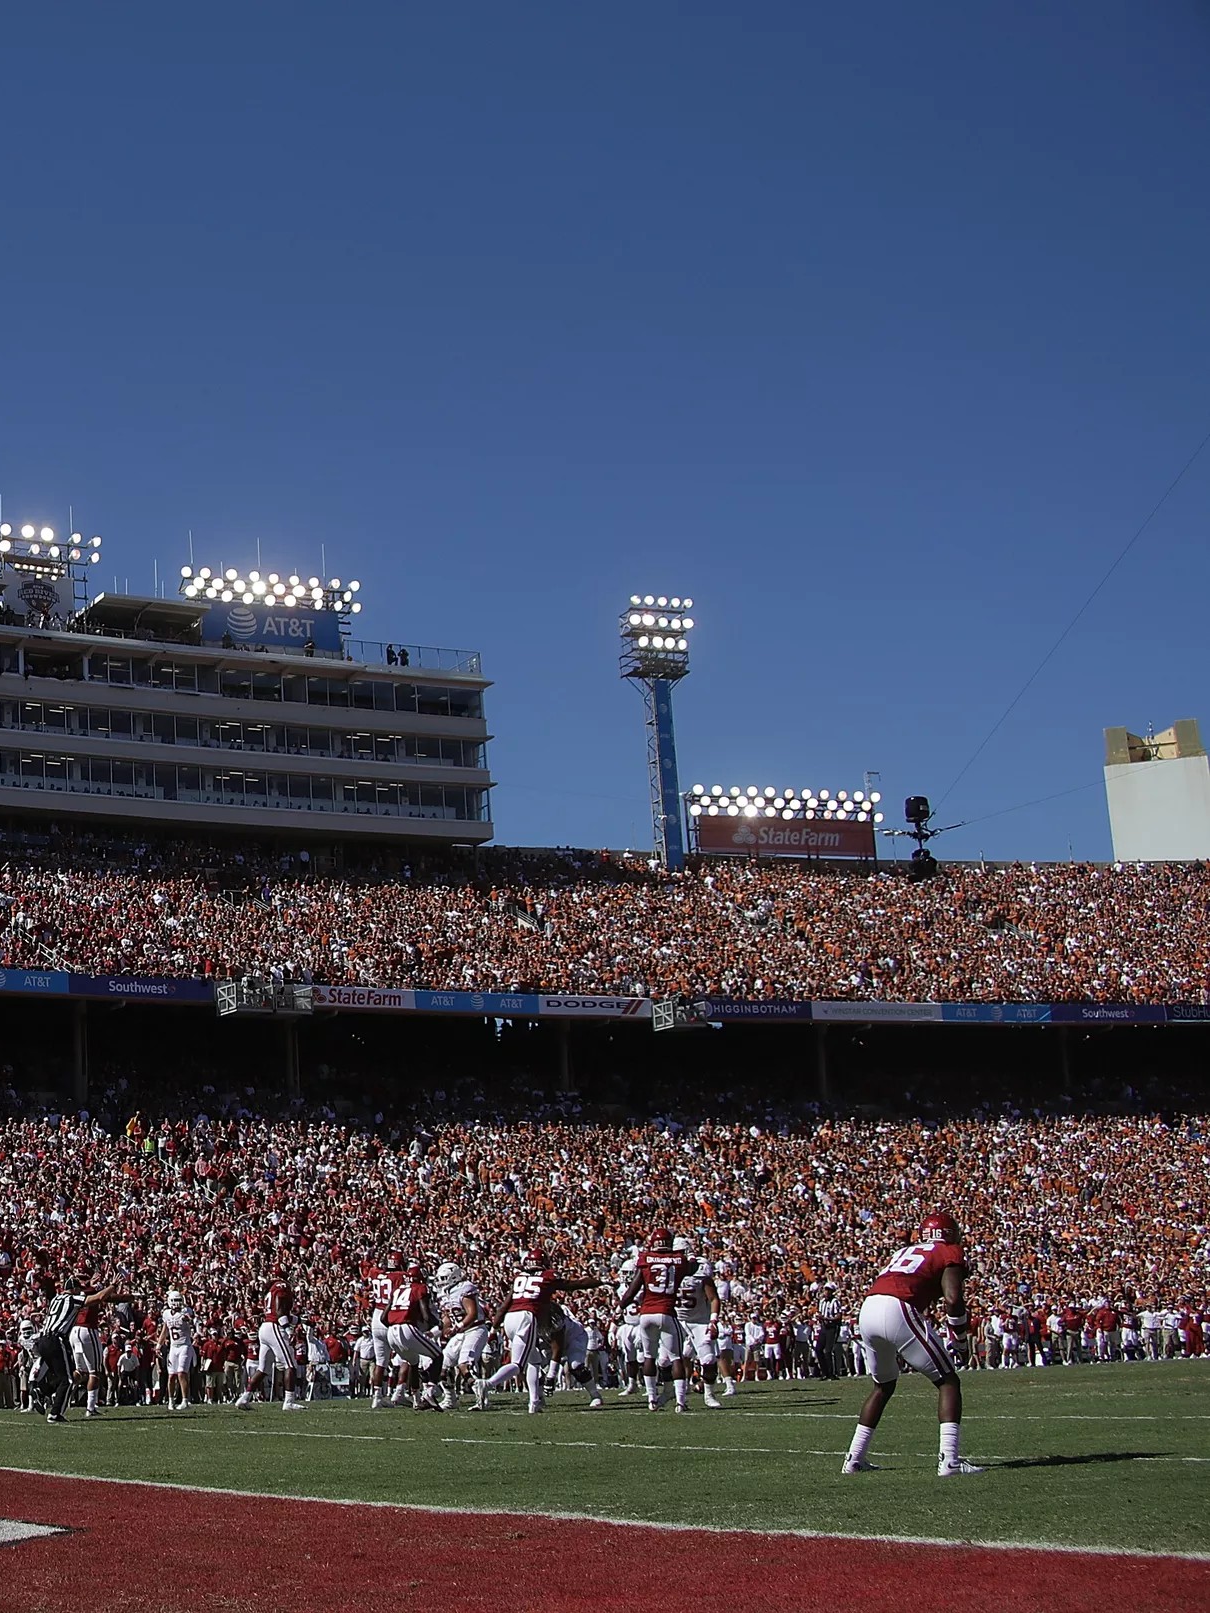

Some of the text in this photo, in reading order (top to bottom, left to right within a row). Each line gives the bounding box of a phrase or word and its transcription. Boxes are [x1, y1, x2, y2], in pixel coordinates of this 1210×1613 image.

[262, 616, 314, 638] AT&T
[24, 976, 50, 987] AT&T
[108, 980, 168, 994] Southwest
[431, 996, 456, 1006] AT&T
[500, 998, 524, 1008] AT&T
[546, 1000, 630, 1010] DODGE
[714, 1004, 797, 1014] HIGGINBOTHAM
[956, 1008, 977, 1017] AT&T
[1016, 1008, 1037, 1018] AT&T
[1082, 1008, 1130, 1018] Southwest
[932, 1228, 942, 1238] 16
[648, 1264, 676, 1294] 31
[372, 1279, 392, 1304] 93
[512, 1276, 544, 1299] 95
[391, 1284, 412, 1310] 14
[170, 1326, 180, 1340] 6
